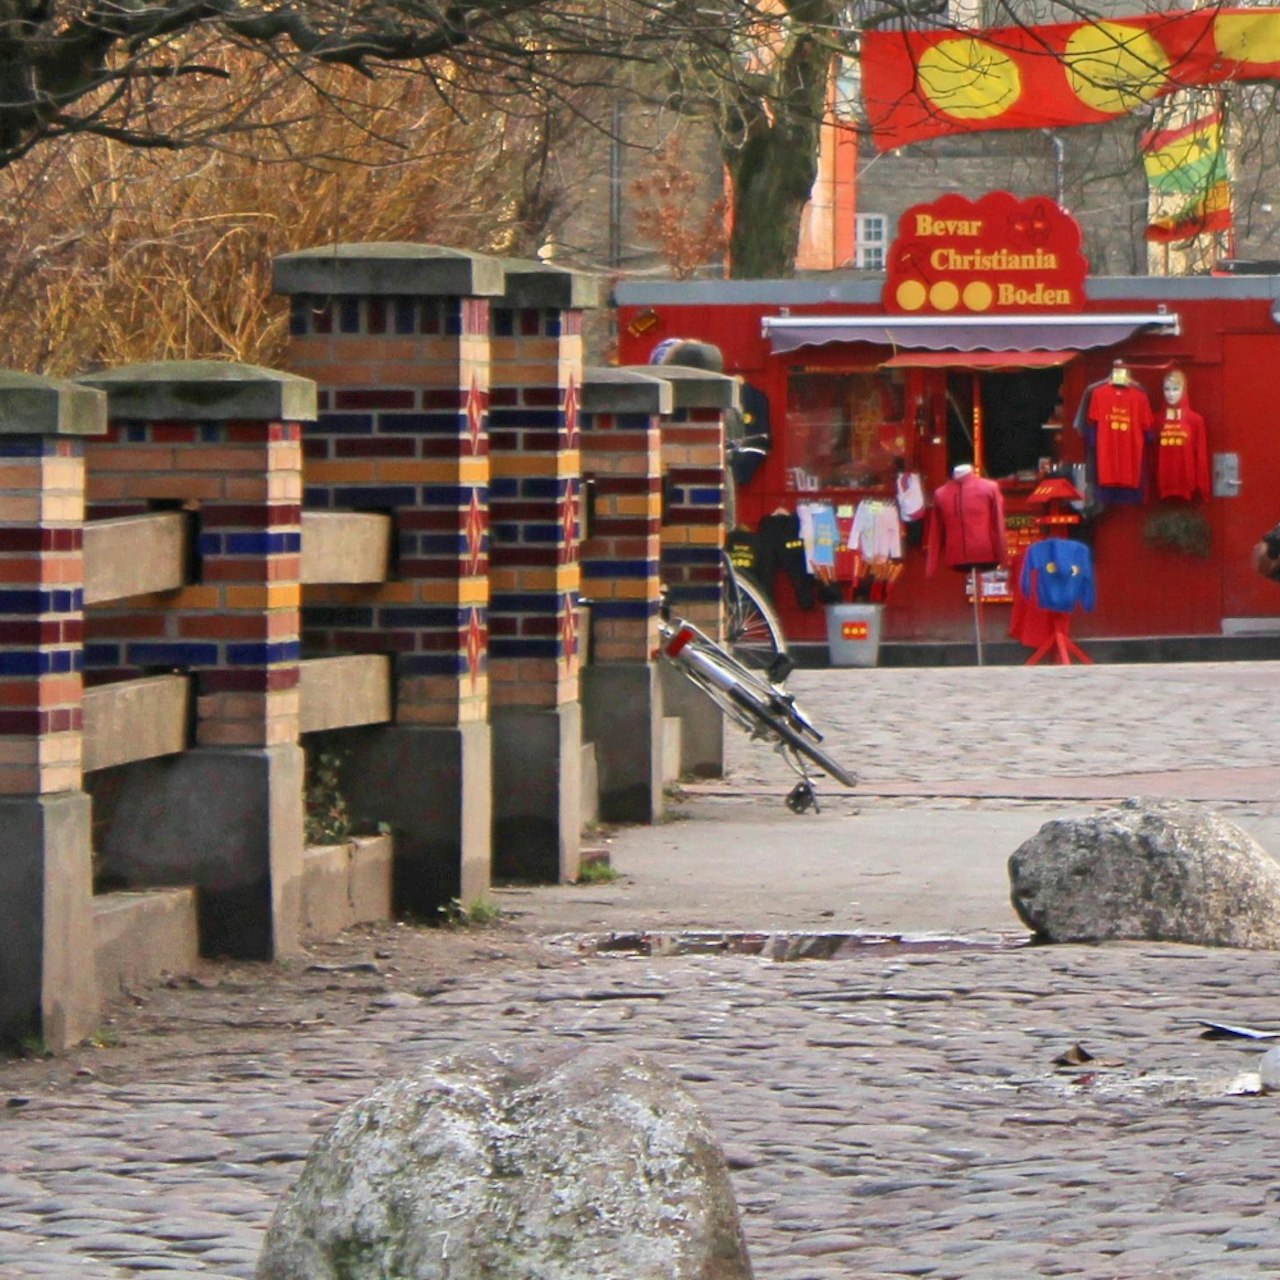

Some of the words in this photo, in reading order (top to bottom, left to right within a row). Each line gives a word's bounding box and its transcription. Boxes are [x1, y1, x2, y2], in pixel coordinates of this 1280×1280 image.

[915, 214, 982, 237] Bevar
[930, 248, 1058, 270] Christiania
[997, 283, 1071, 306] Boden
